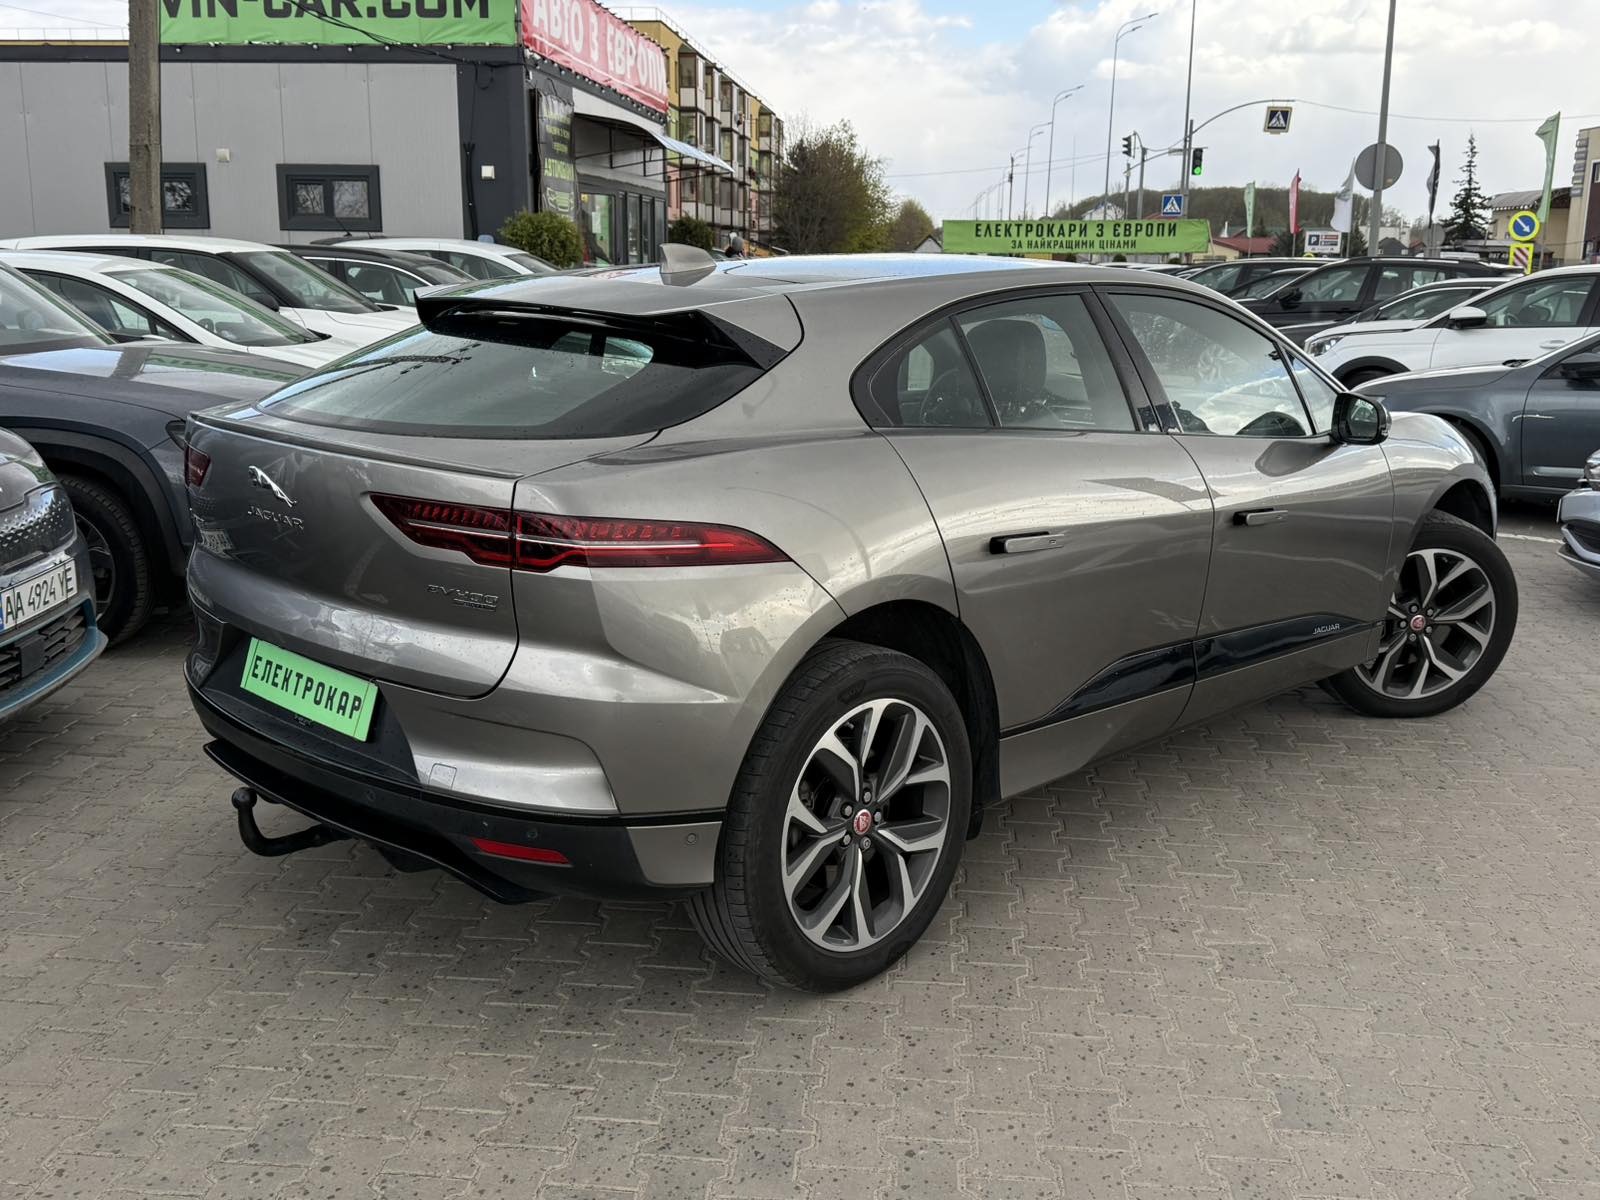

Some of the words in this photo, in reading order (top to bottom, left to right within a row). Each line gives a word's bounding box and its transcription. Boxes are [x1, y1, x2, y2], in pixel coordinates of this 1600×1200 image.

[975, 223, 1088, 237] ЕЛЕКТРОКАРИ
[1113, 223, 1177, 237] ЄВРОПИ
[1011, 240, 1023, 249] ЗА
[1027, 238, 1095, 251] НАЙКРАЩИМИ
[1099, 240, 1137, 250] ЦІНАМИ
[247, 505, 304, 530] JAGUAR
[6, 592, 25, 624] AA
[28, 576, 56, 611] 4924
[1312, 623, 1340, 635] JAGUAR
[251, 655, 362, 720] ЕЛЕКТРОКАР
